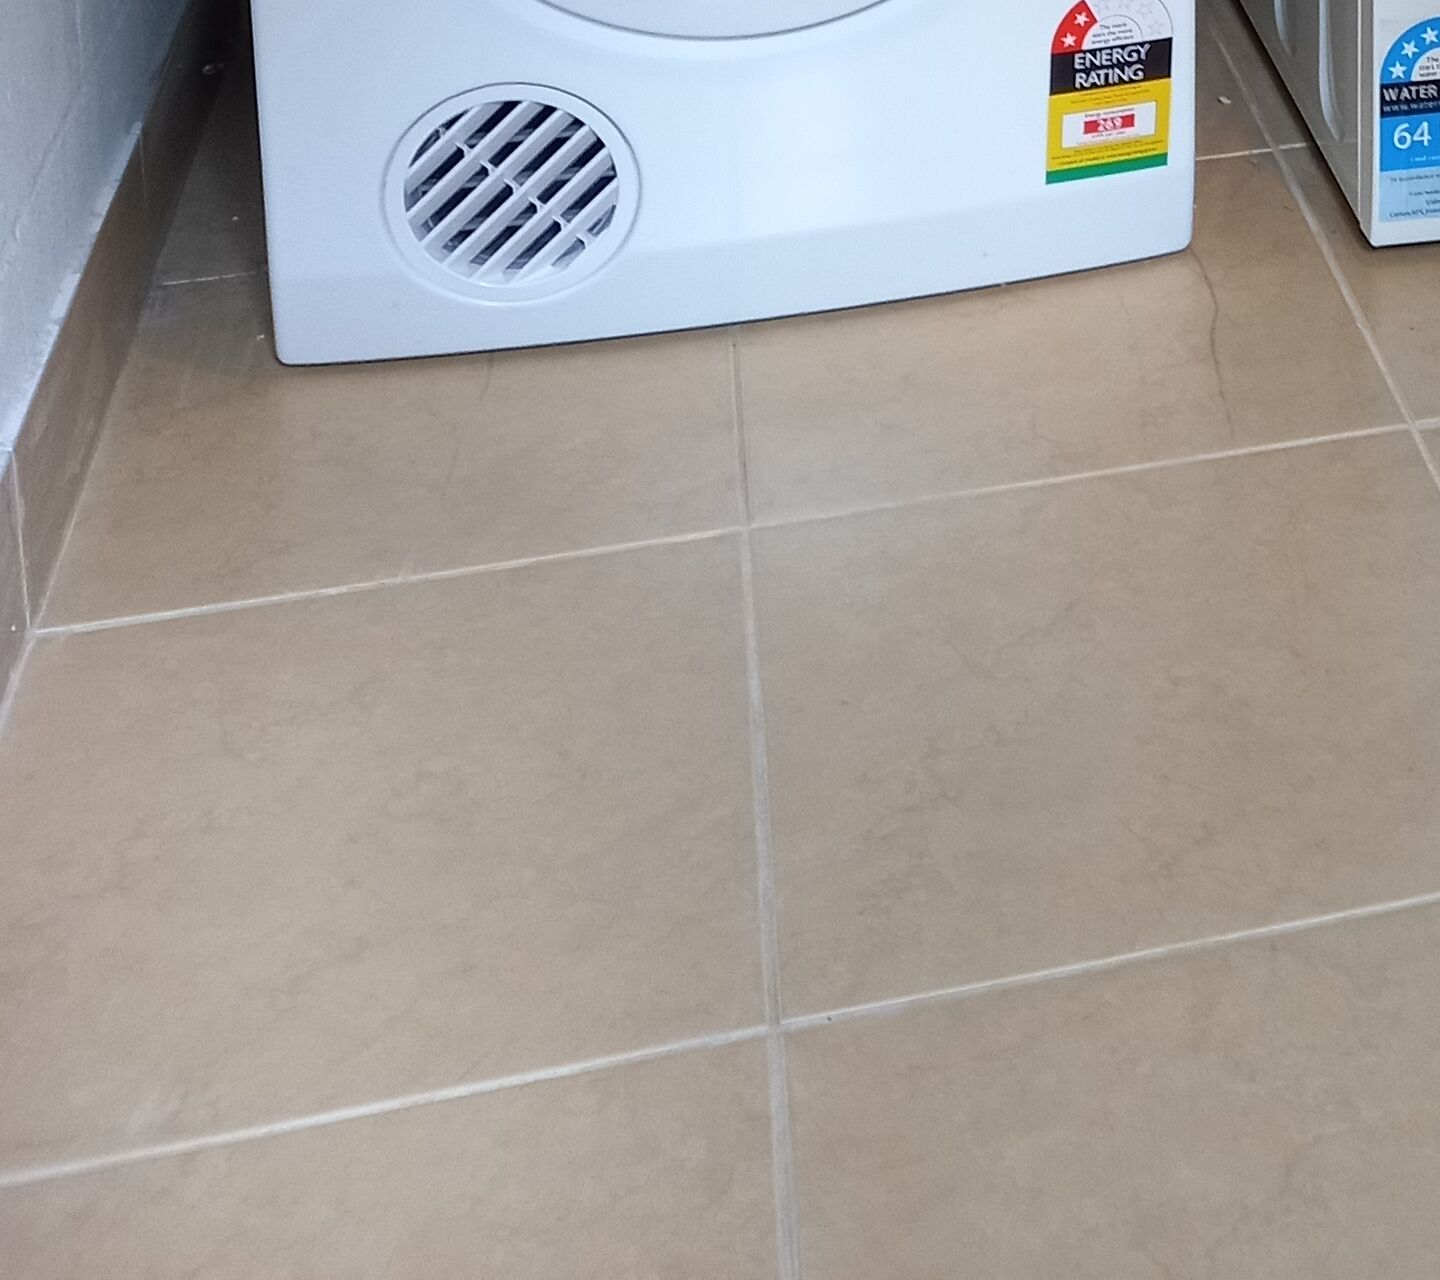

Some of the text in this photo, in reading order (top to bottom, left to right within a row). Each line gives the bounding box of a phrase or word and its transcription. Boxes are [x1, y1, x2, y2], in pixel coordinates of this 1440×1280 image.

[1074, 43, 1151, 70] ENERGY
[1074, 63, 1145, 89] RATING
[1383, 84, 1439, 102] WATER
[1393, 121, 1432, 149] 64
